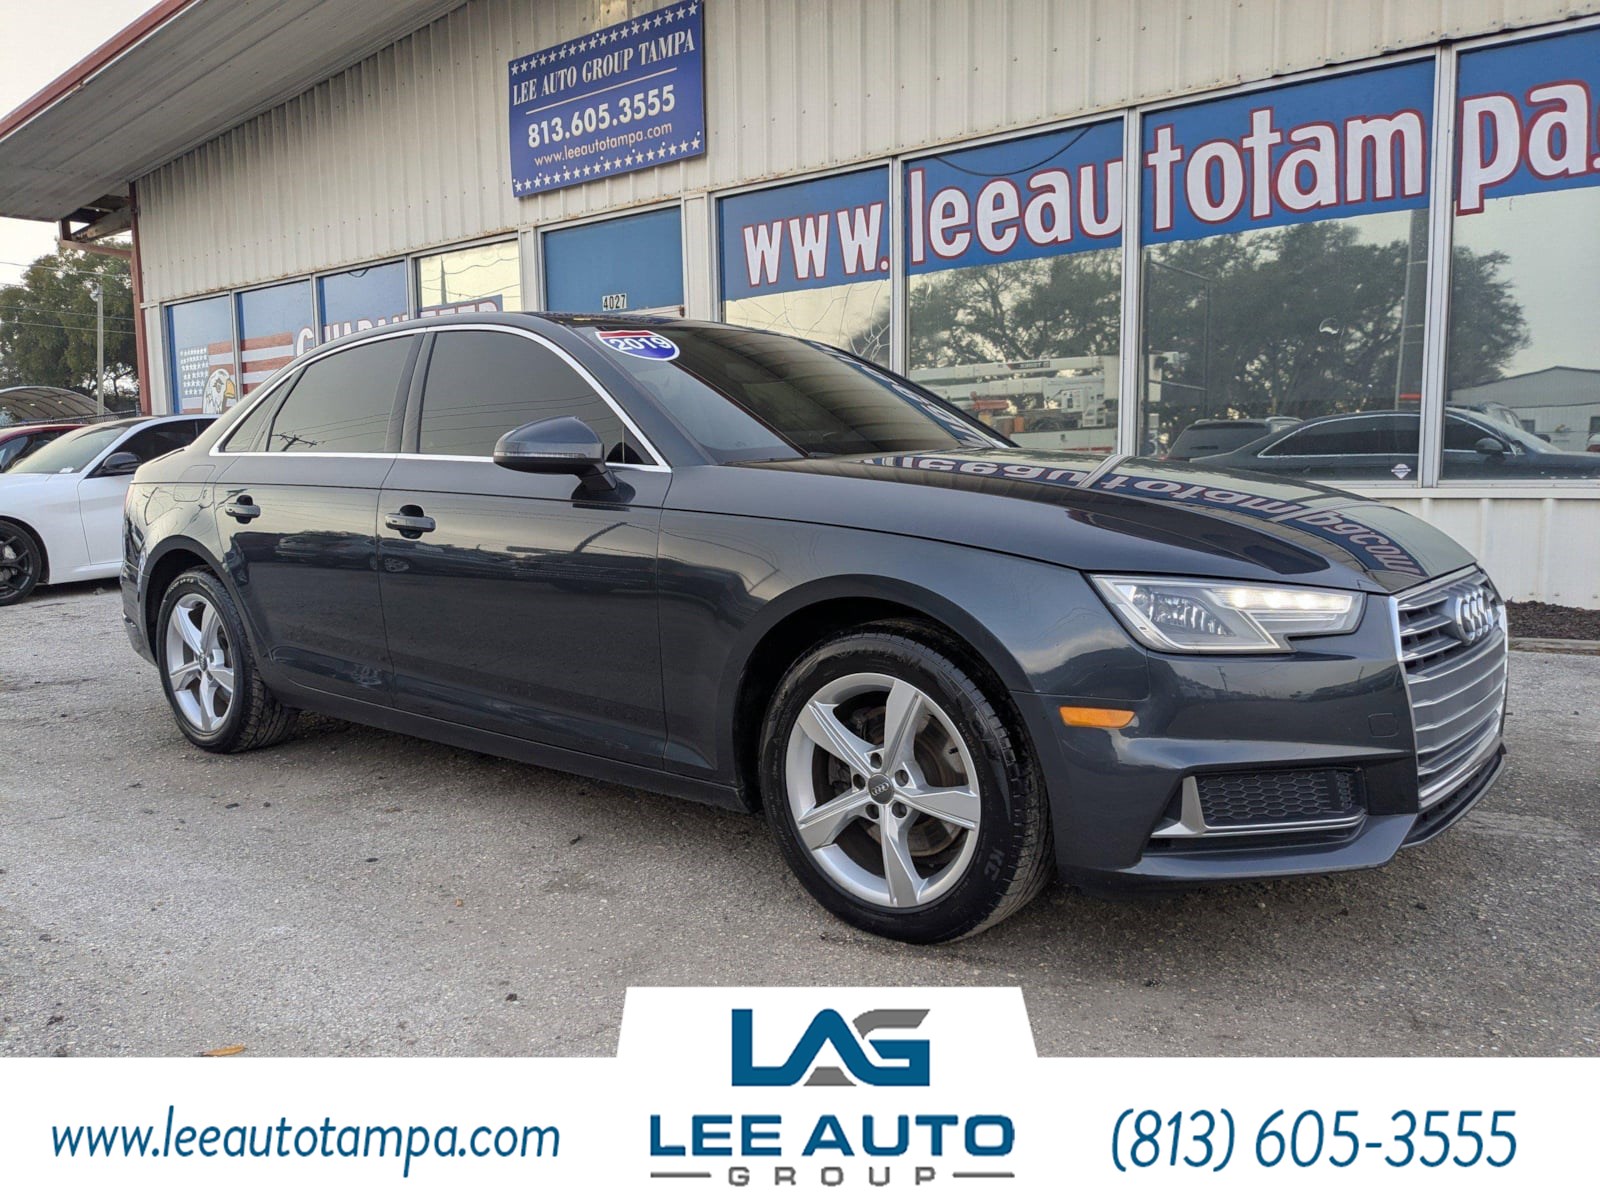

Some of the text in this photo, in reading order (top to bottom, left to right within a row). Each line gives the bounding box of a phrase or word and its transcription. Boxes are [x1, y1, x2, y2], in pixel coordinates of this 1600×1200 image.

[512, 28, 695, 106] LEE AUTO GROUP TAMPA
[527, 84, 676, 148] 813.605.3555
[533, 122, 673, 167] www.leeautotampa.com
[602, 294, 627, 310] 4027
[609, 337, 673, 351] 2019
